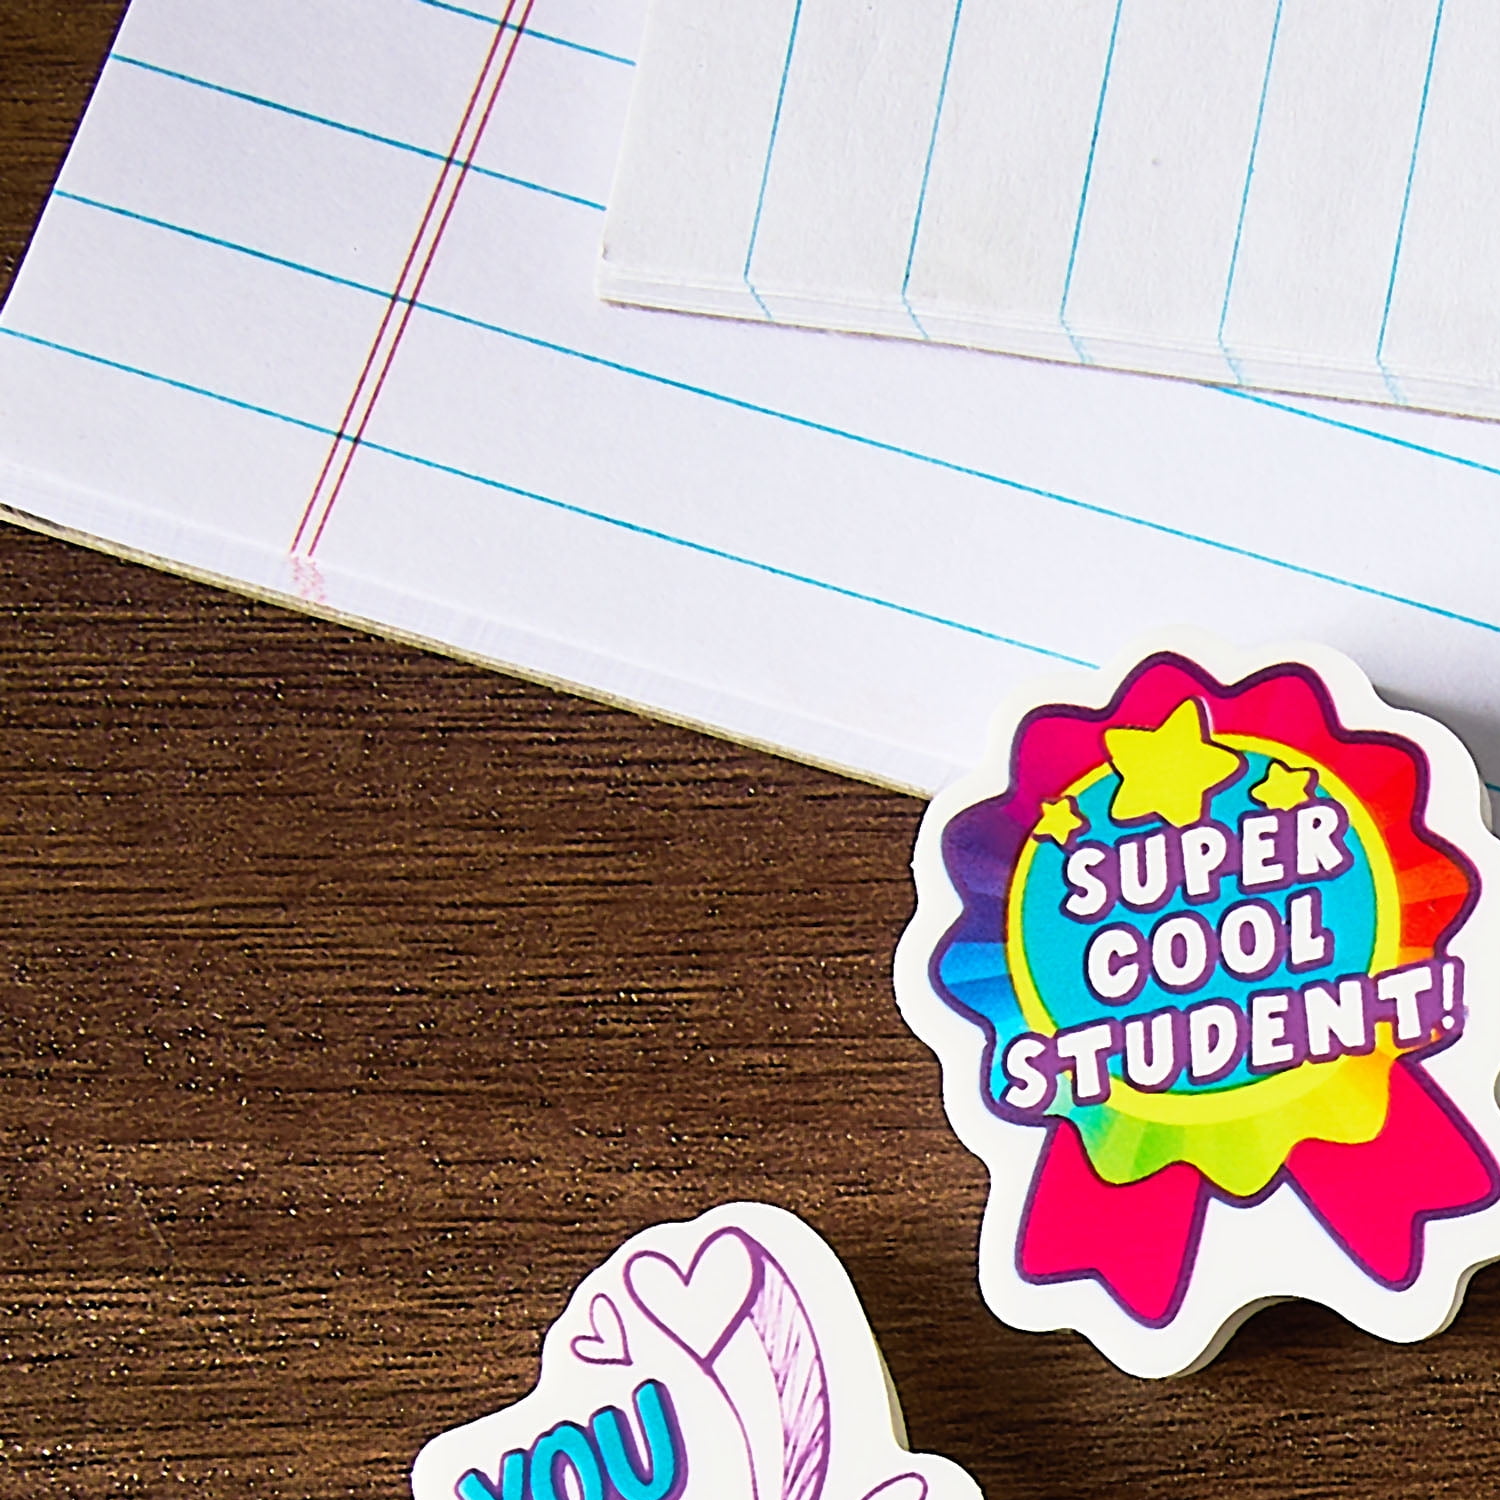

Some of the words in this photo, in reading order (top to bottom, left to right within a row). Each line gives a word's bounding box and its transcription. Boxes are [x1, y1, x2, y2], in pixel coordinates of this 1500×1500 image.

[1064, 806, 1347, 916] SUPER
[1087, 895, 1327, 1000] COOL
[1003, 963, 1456, 1109] STUDENT!
